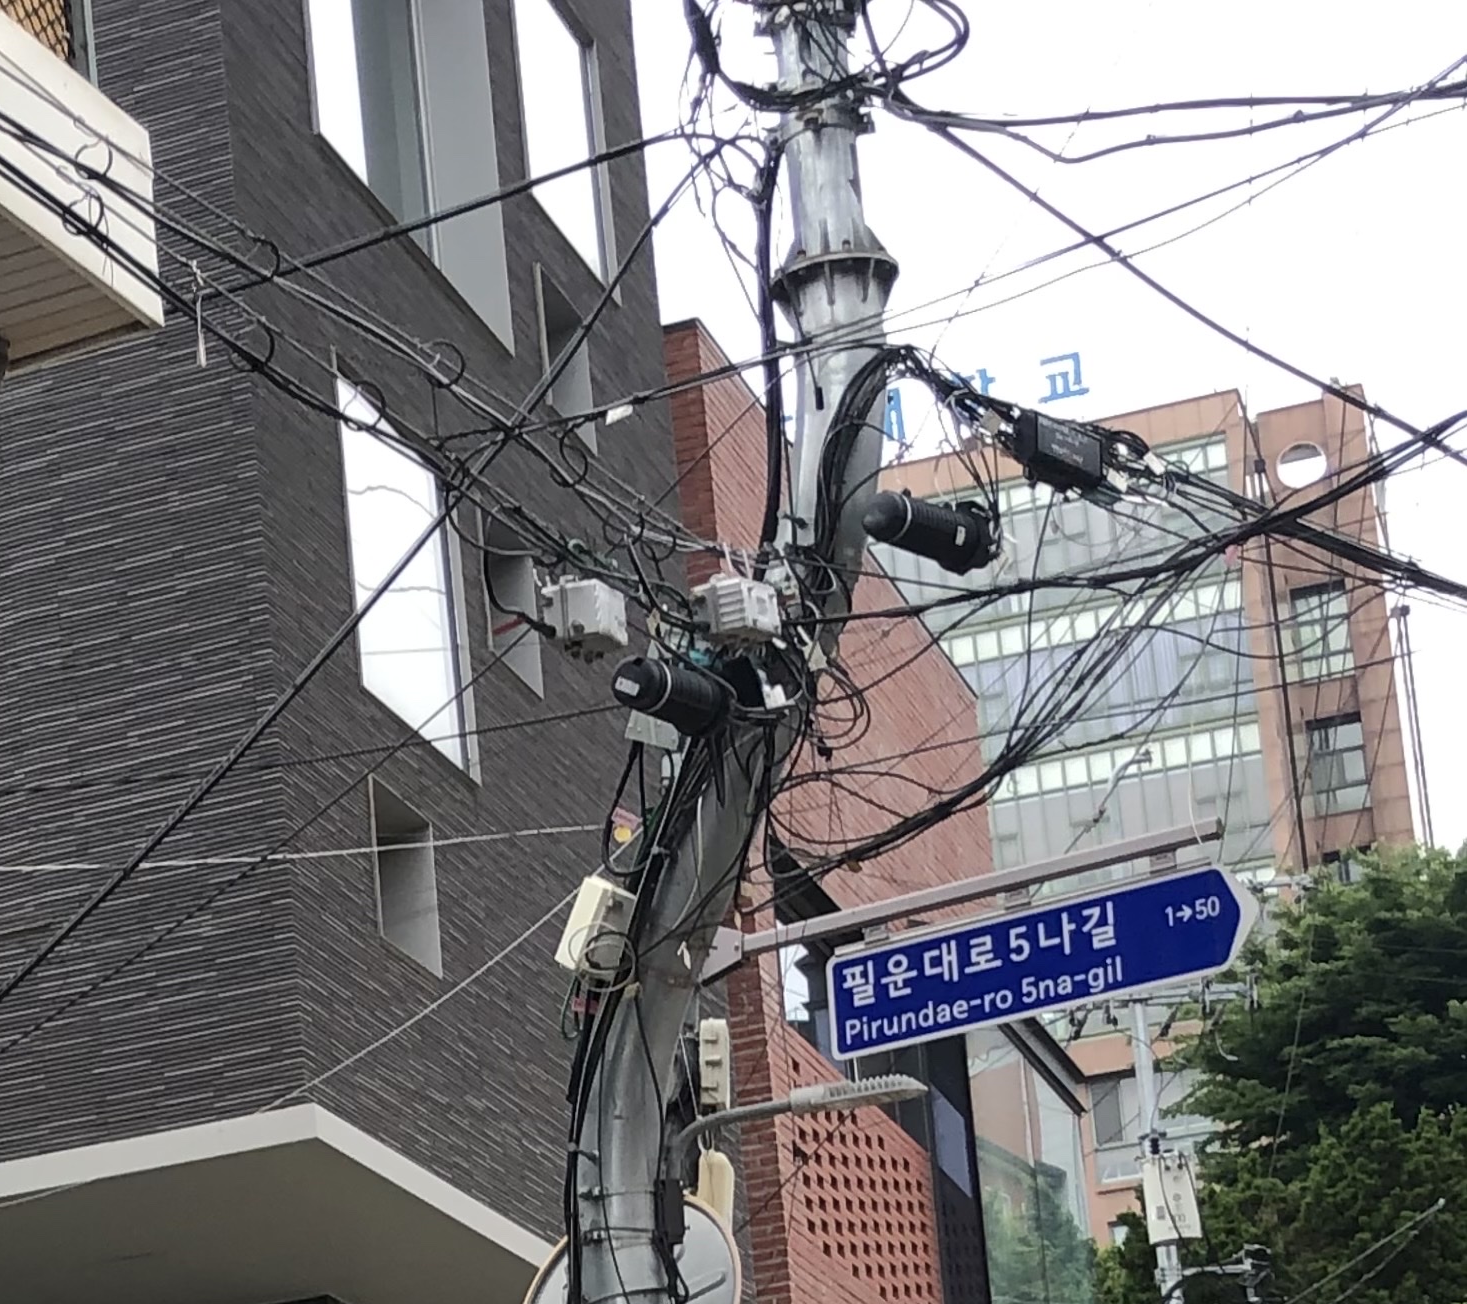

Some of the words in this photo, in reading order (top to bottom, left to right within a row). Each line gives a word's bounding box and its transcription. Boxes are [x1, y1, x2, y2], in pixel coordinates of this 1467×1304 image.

[841, 900, 1118, 1009] 필운대로5나길
[844, 986, 1014, 1046] Pirundae-ro
[1020, 956, 1124, 1004] 5na-gil
